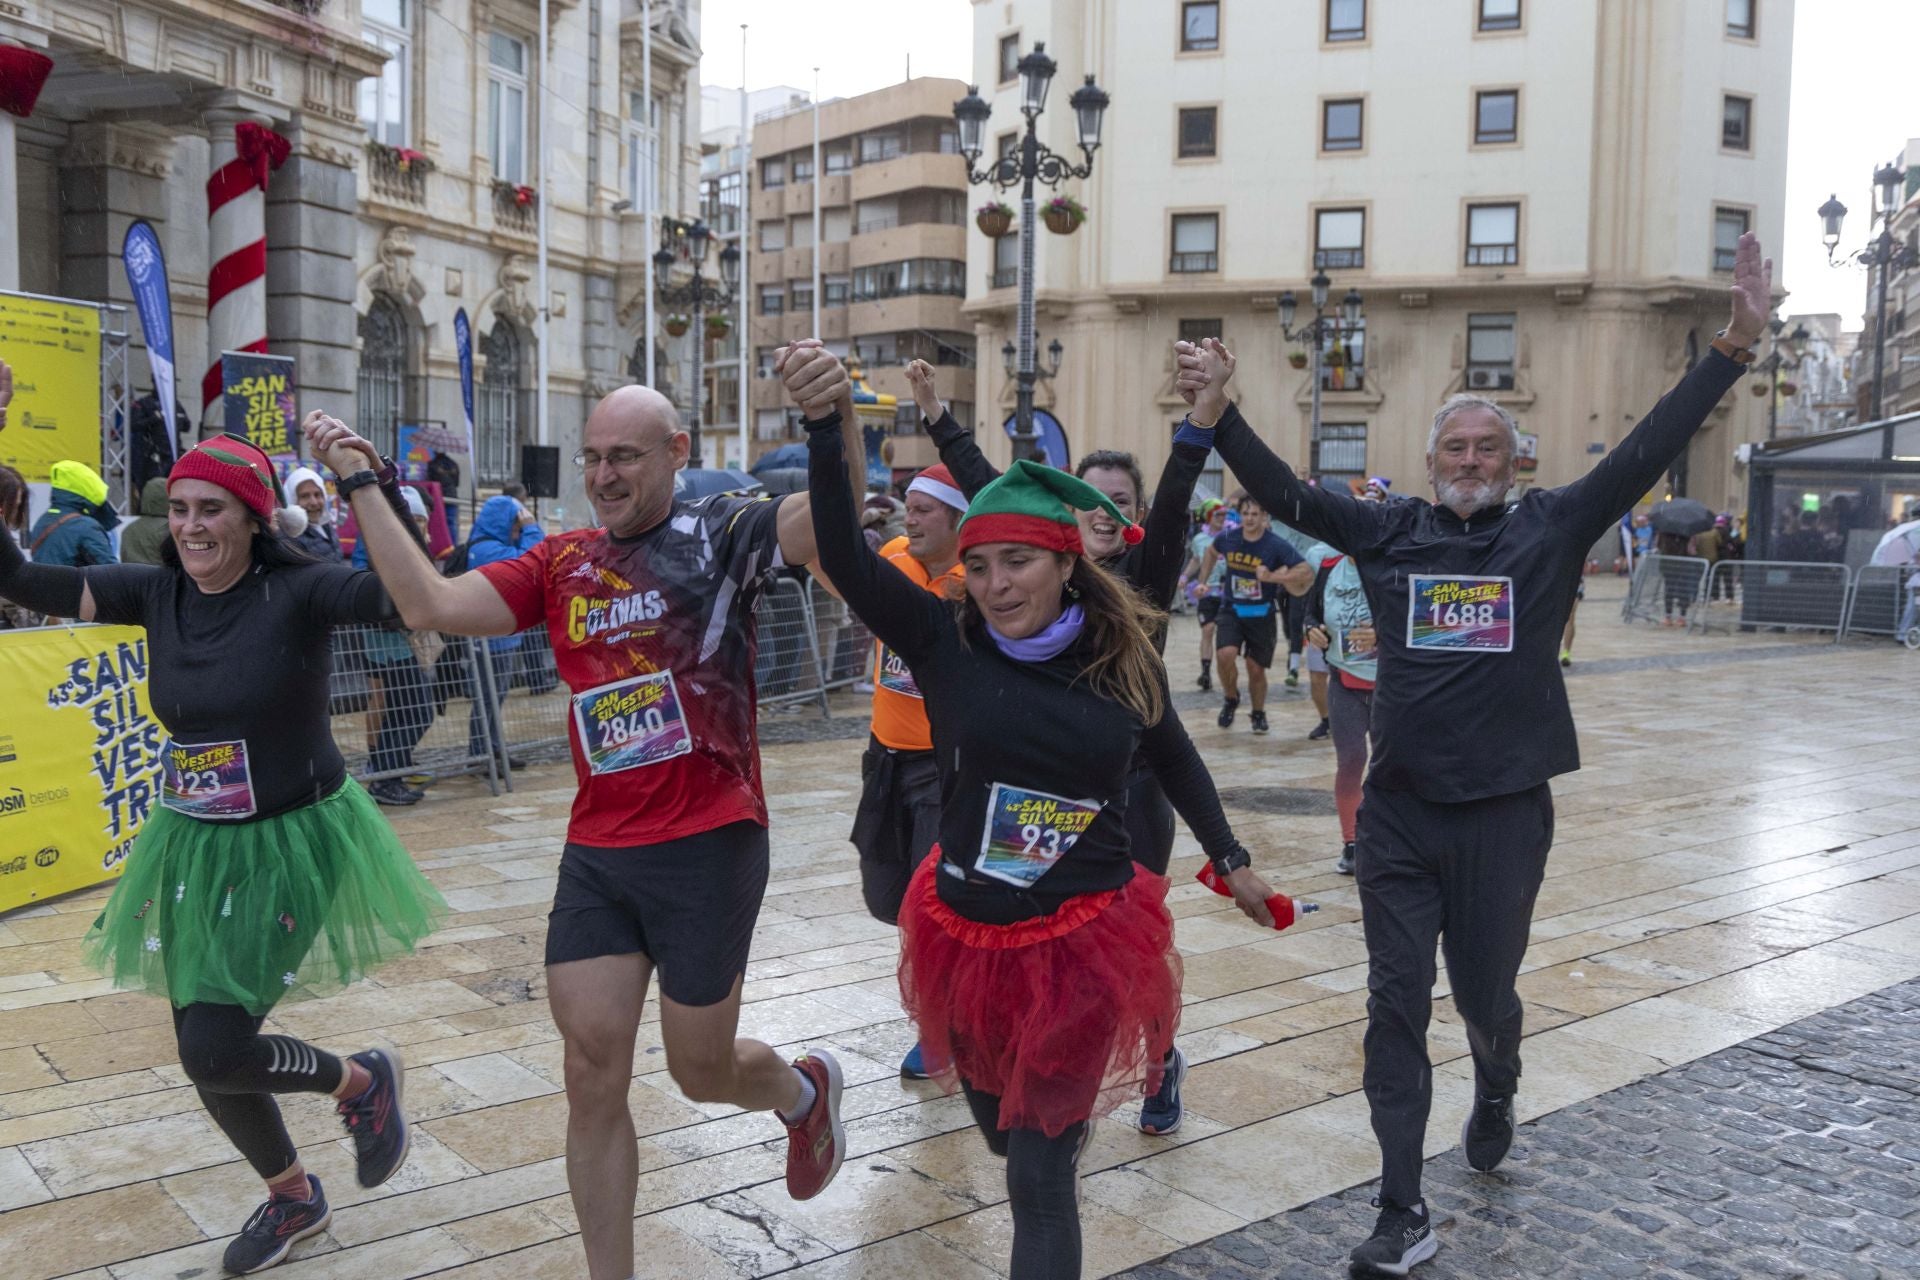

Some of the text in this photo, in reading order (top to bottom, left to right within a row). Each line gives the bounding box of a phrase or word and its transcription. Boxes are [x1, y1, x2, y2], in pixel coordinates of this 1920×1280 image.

[242, 375, 286, 397] SAN
[248, 393, 279, 415] SIL
[245, 410, 286, 432] VES
[247, 428, 288, 449] TRE
[1433, 582, 1460, 595] SAN
[1433, 583, 1502, 604] SILVESTRE
[1429, 603, 1494, 627] 1688
[65, 638, 149, 705] SAN
[596, 691, 619, 713] SAN
[88, 686, 148, 746] SIL
[598, 707, 665, 748] 2840
[90, 723, 164, 792] VES
[30, 786, 69, 805] berbois
[1020, 799, 1058, 813] SAN
